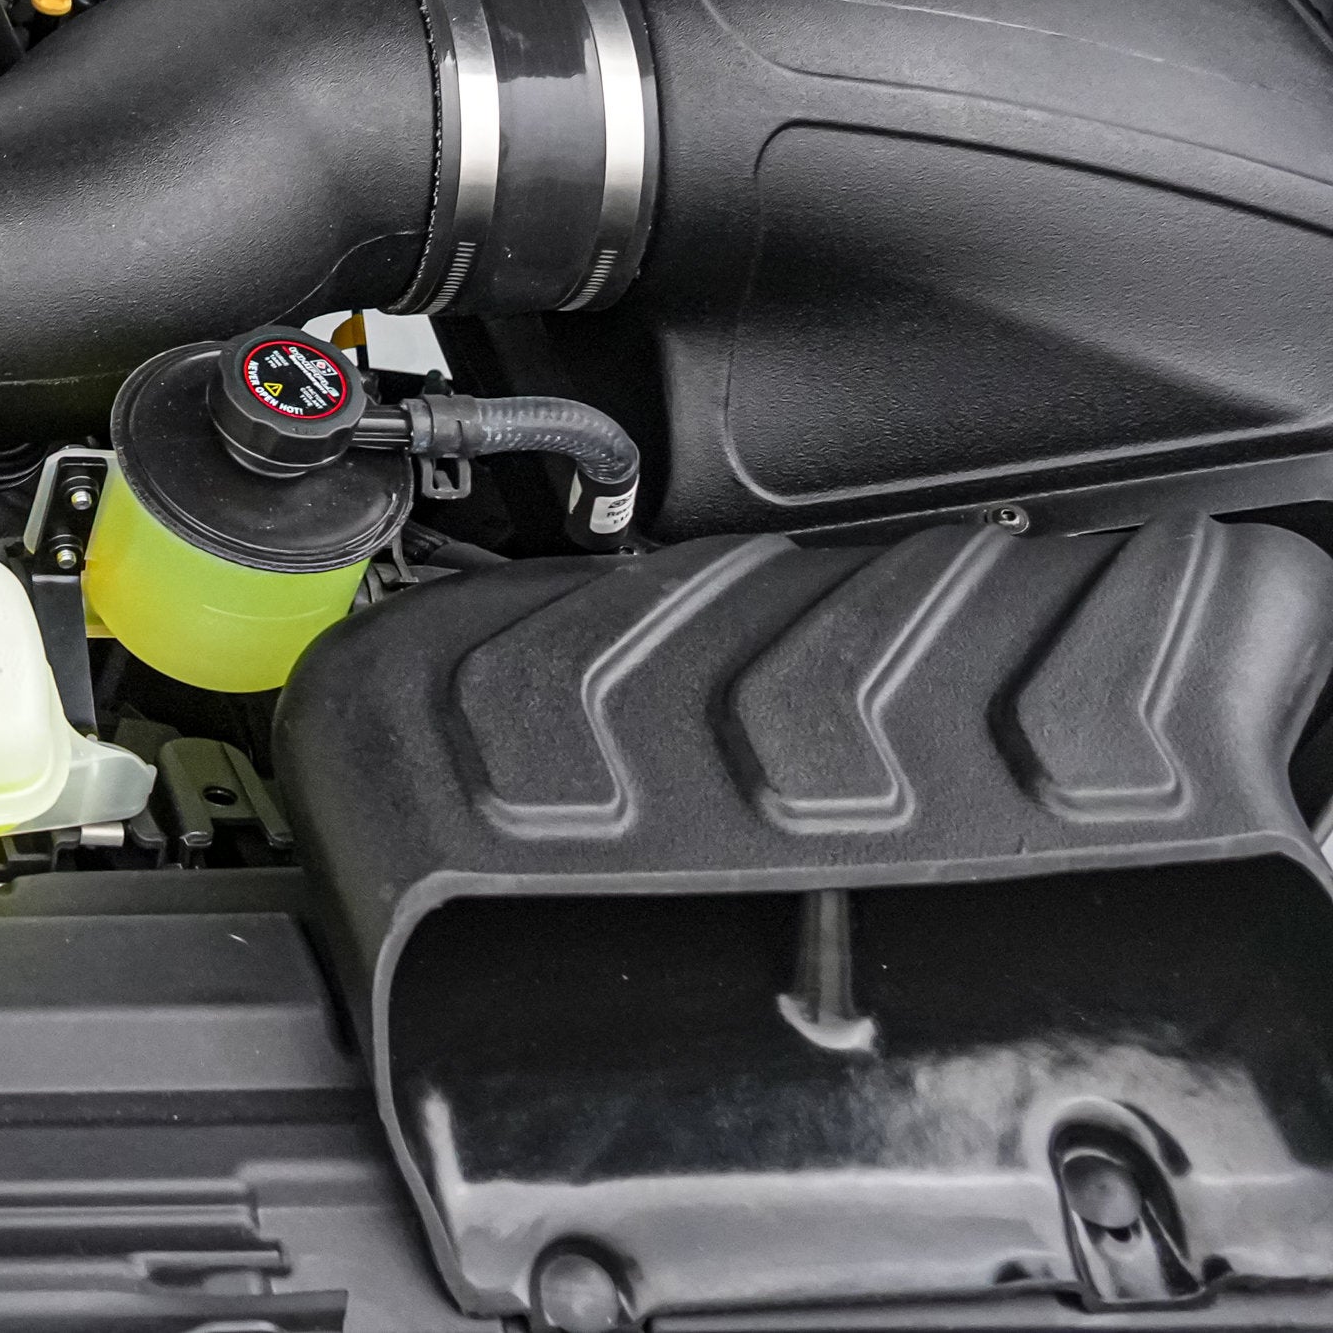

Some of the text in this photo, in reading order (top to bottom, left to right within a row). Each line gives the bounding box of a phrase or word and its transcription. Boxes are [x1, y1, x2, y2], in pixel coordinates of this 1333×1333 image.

[247, 360, 304, 415] NEVER OPEN HOT!
